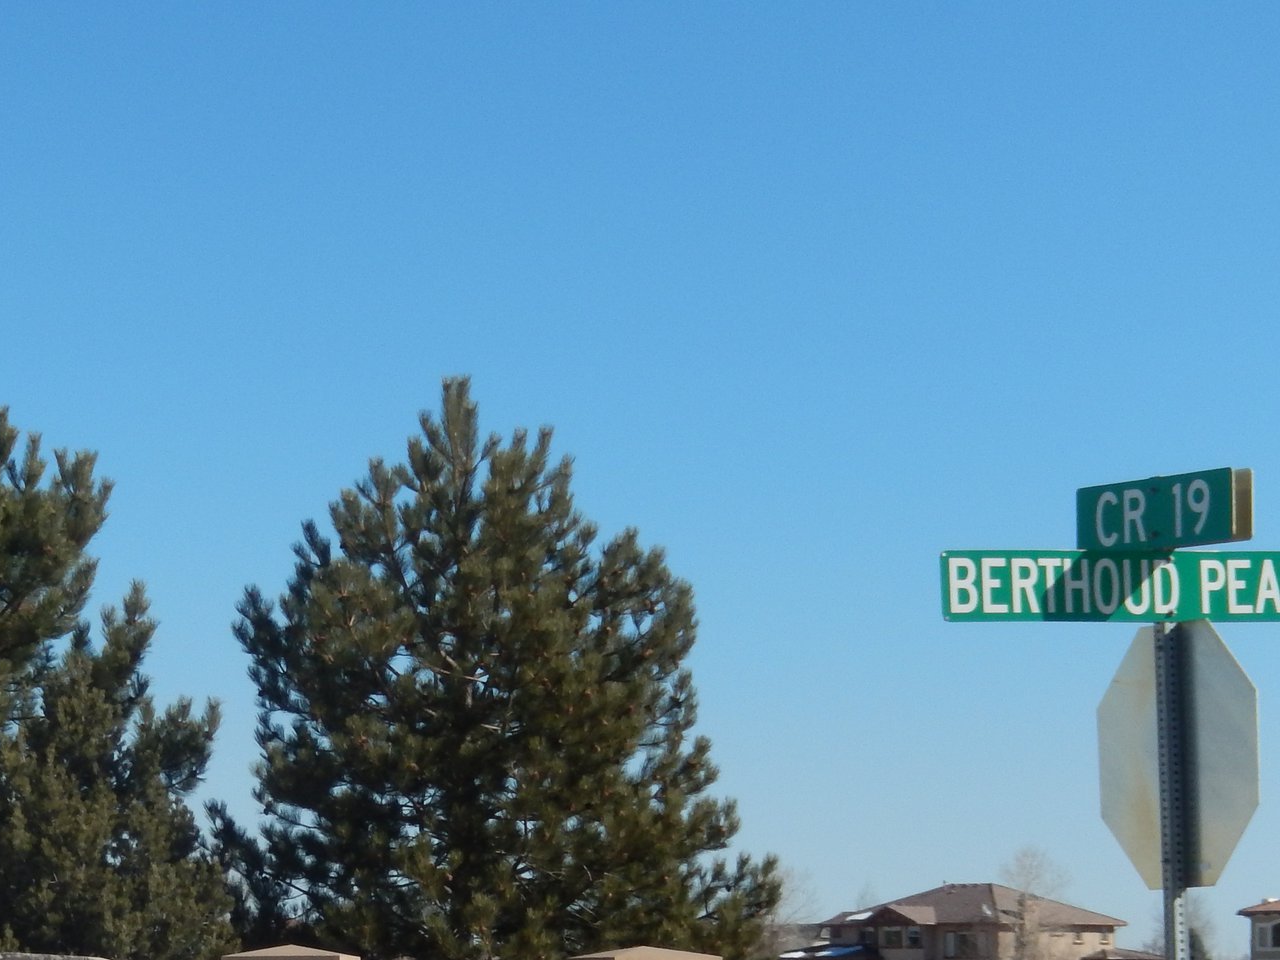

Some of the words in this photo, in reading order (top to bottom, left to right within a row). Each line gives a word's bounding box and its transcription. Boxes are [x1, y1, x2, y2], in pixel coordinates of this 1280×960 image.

[1095, 490, 1146, 547] CR
[1171, 479, 1210, 537] 19
[948, 557, 1179, 614] BERTHOUD
[1199, 559, 1280, 614] PEA
